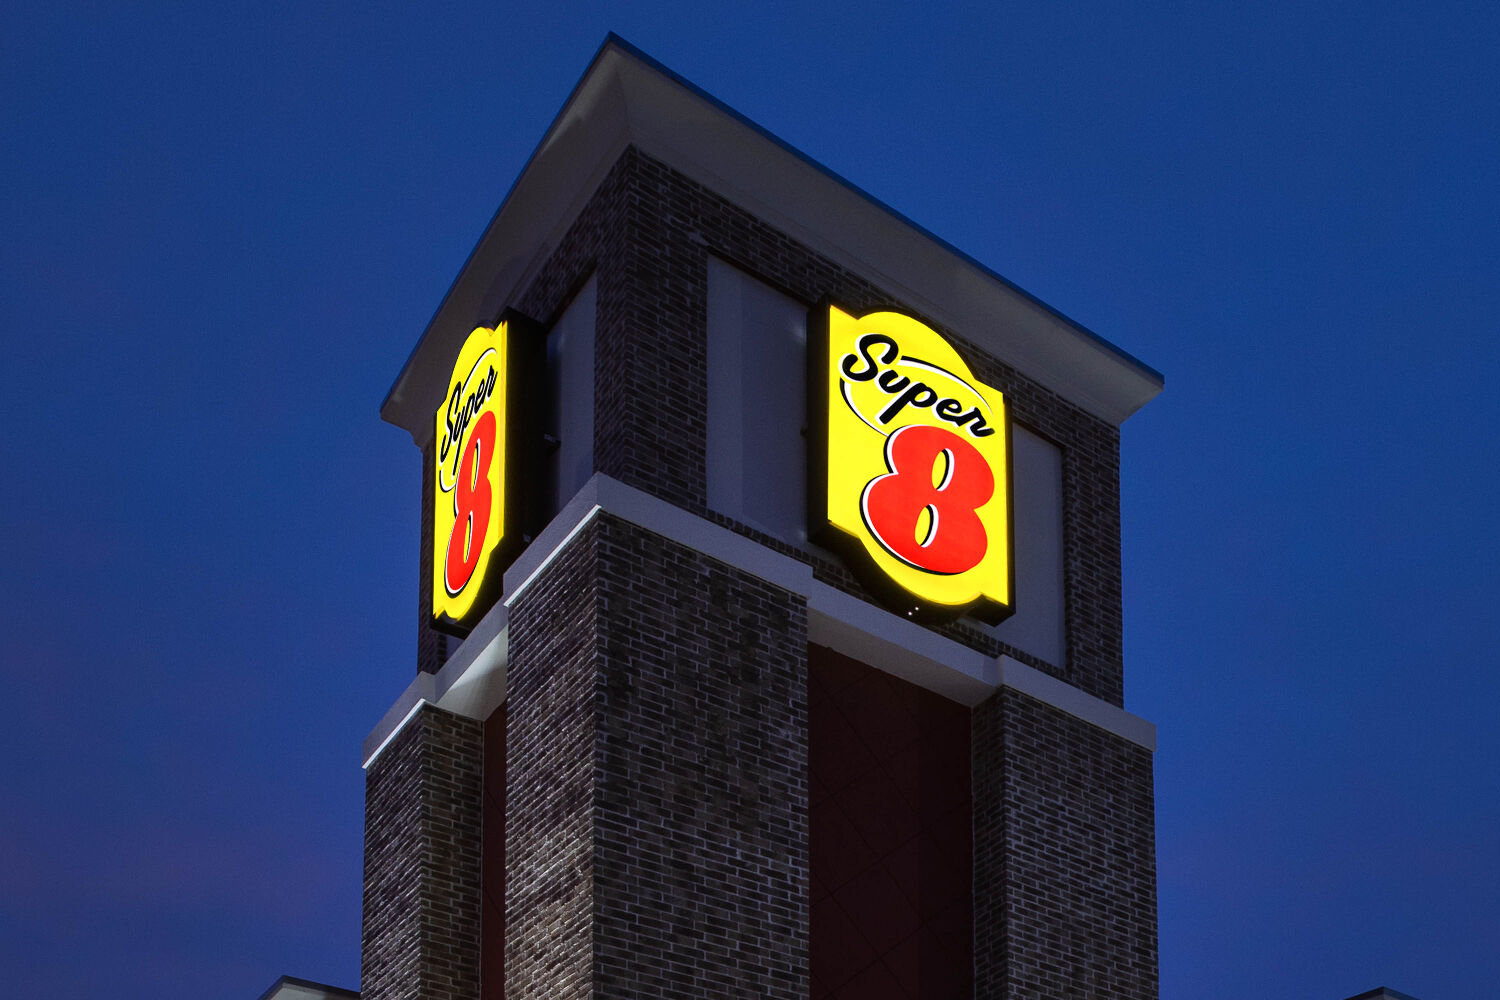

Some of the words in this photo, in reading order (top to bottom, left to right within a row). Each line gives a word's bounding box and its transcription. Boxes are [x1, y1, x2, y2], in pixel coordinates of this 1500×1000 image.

[439, 364, 498, 477] Super
[837, 333, 995, 439] Super
[444, 410, 497, 597] 8
[859, 423, 996, 577] 8
